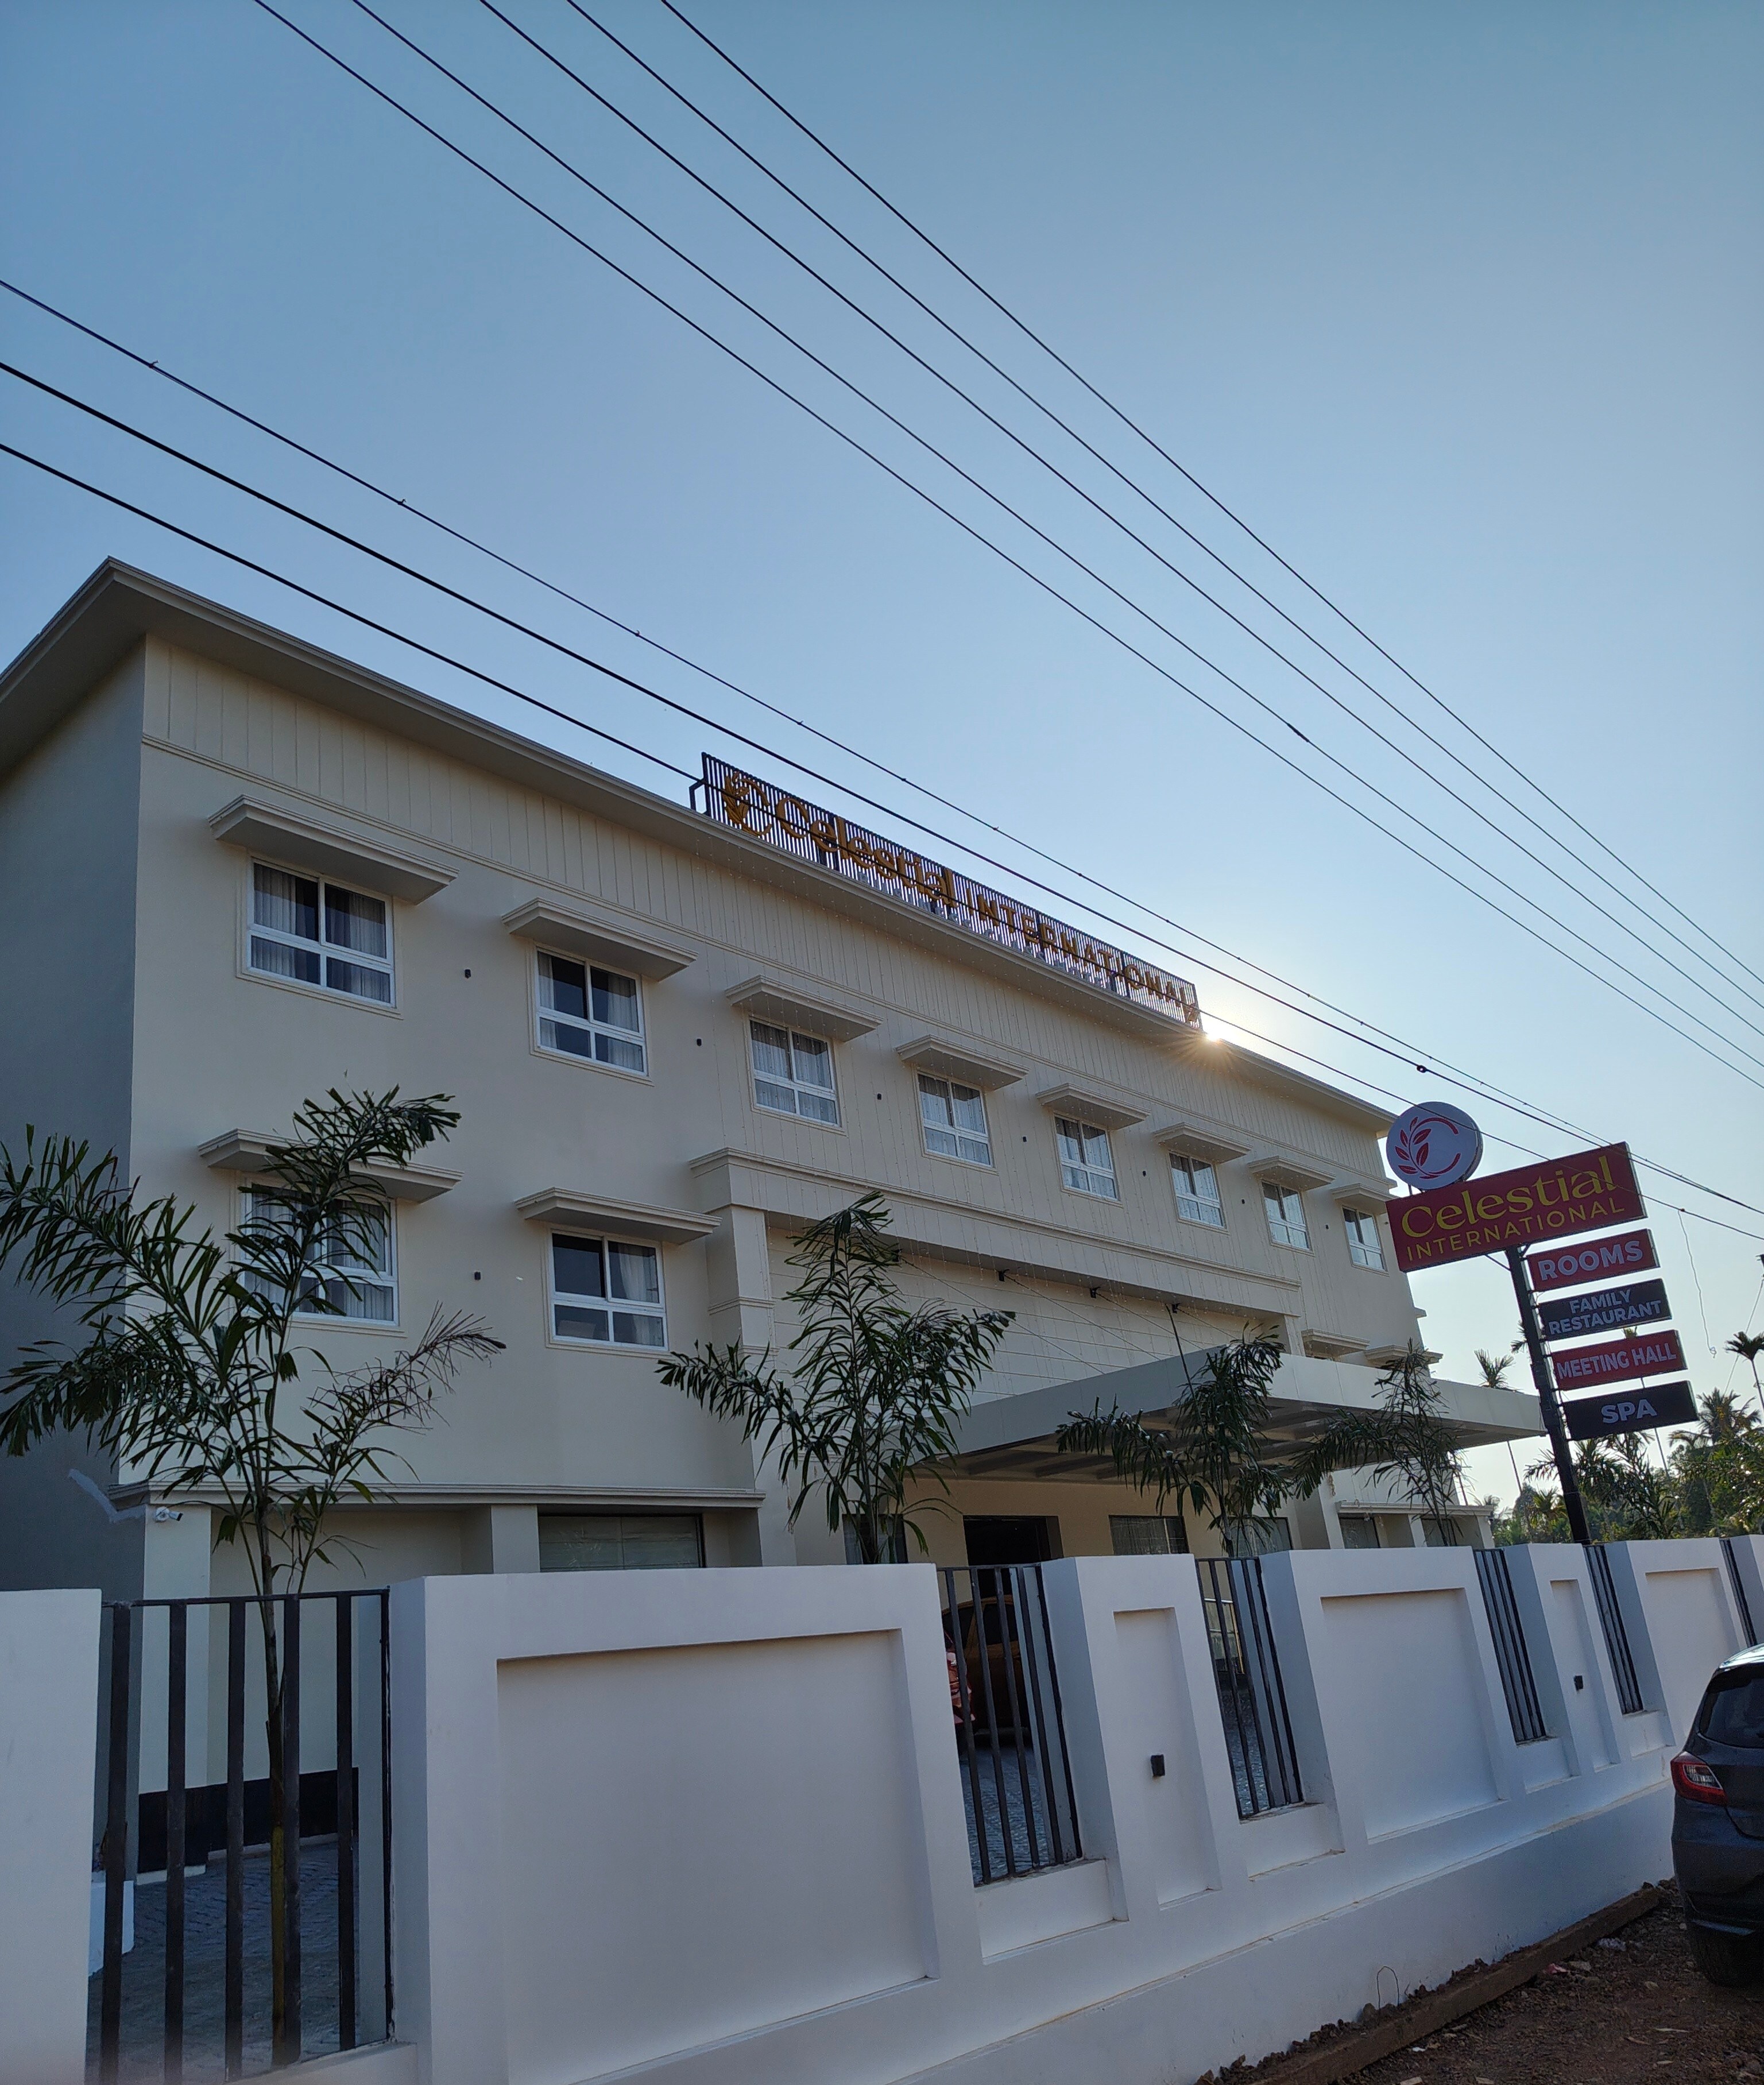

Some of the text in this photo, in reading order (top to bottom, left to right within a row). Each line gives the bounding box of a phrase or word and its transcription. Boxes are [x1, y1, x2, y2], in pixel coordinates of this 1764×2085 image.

[776, 797, 1194, 1015] Celestial INTERNATIONAL
[1401, 1155, 1616, 1238] Celestial
[1407, 1197, 1624, 1262] INTERNATIONAL
[1538, 1240, 1643, 1281] ROOMS
[1549, 1300, 1661, 1336] RESTAURANT
[1570, 1289, 1632, 1315] FAMILY
[1556, 1343, 1677, 1380] MEETING HALL
[1600, 1399, 1657, 1424] SPA
